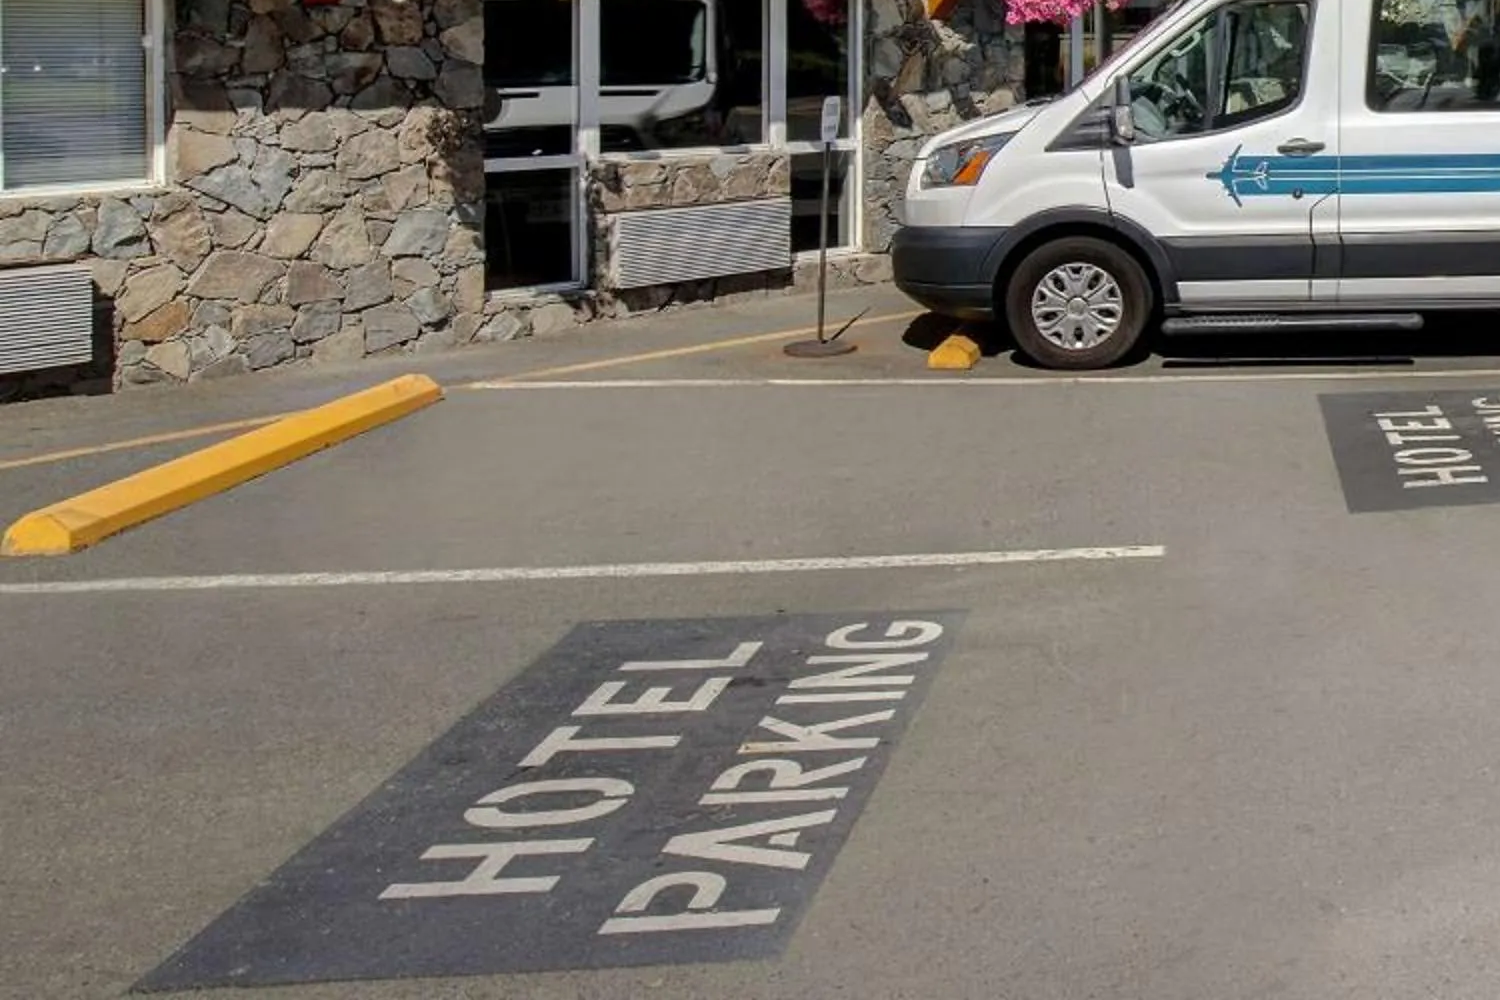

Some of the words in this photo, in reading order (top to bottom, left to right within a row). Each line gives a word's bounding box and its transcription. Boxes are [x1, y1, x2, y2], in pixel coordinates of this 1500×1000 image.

[1373, 405, 1488, 489] HOTEL
[377, 641, 763, 900] HOTEL
[598, 619, 944, 935] PARKING
